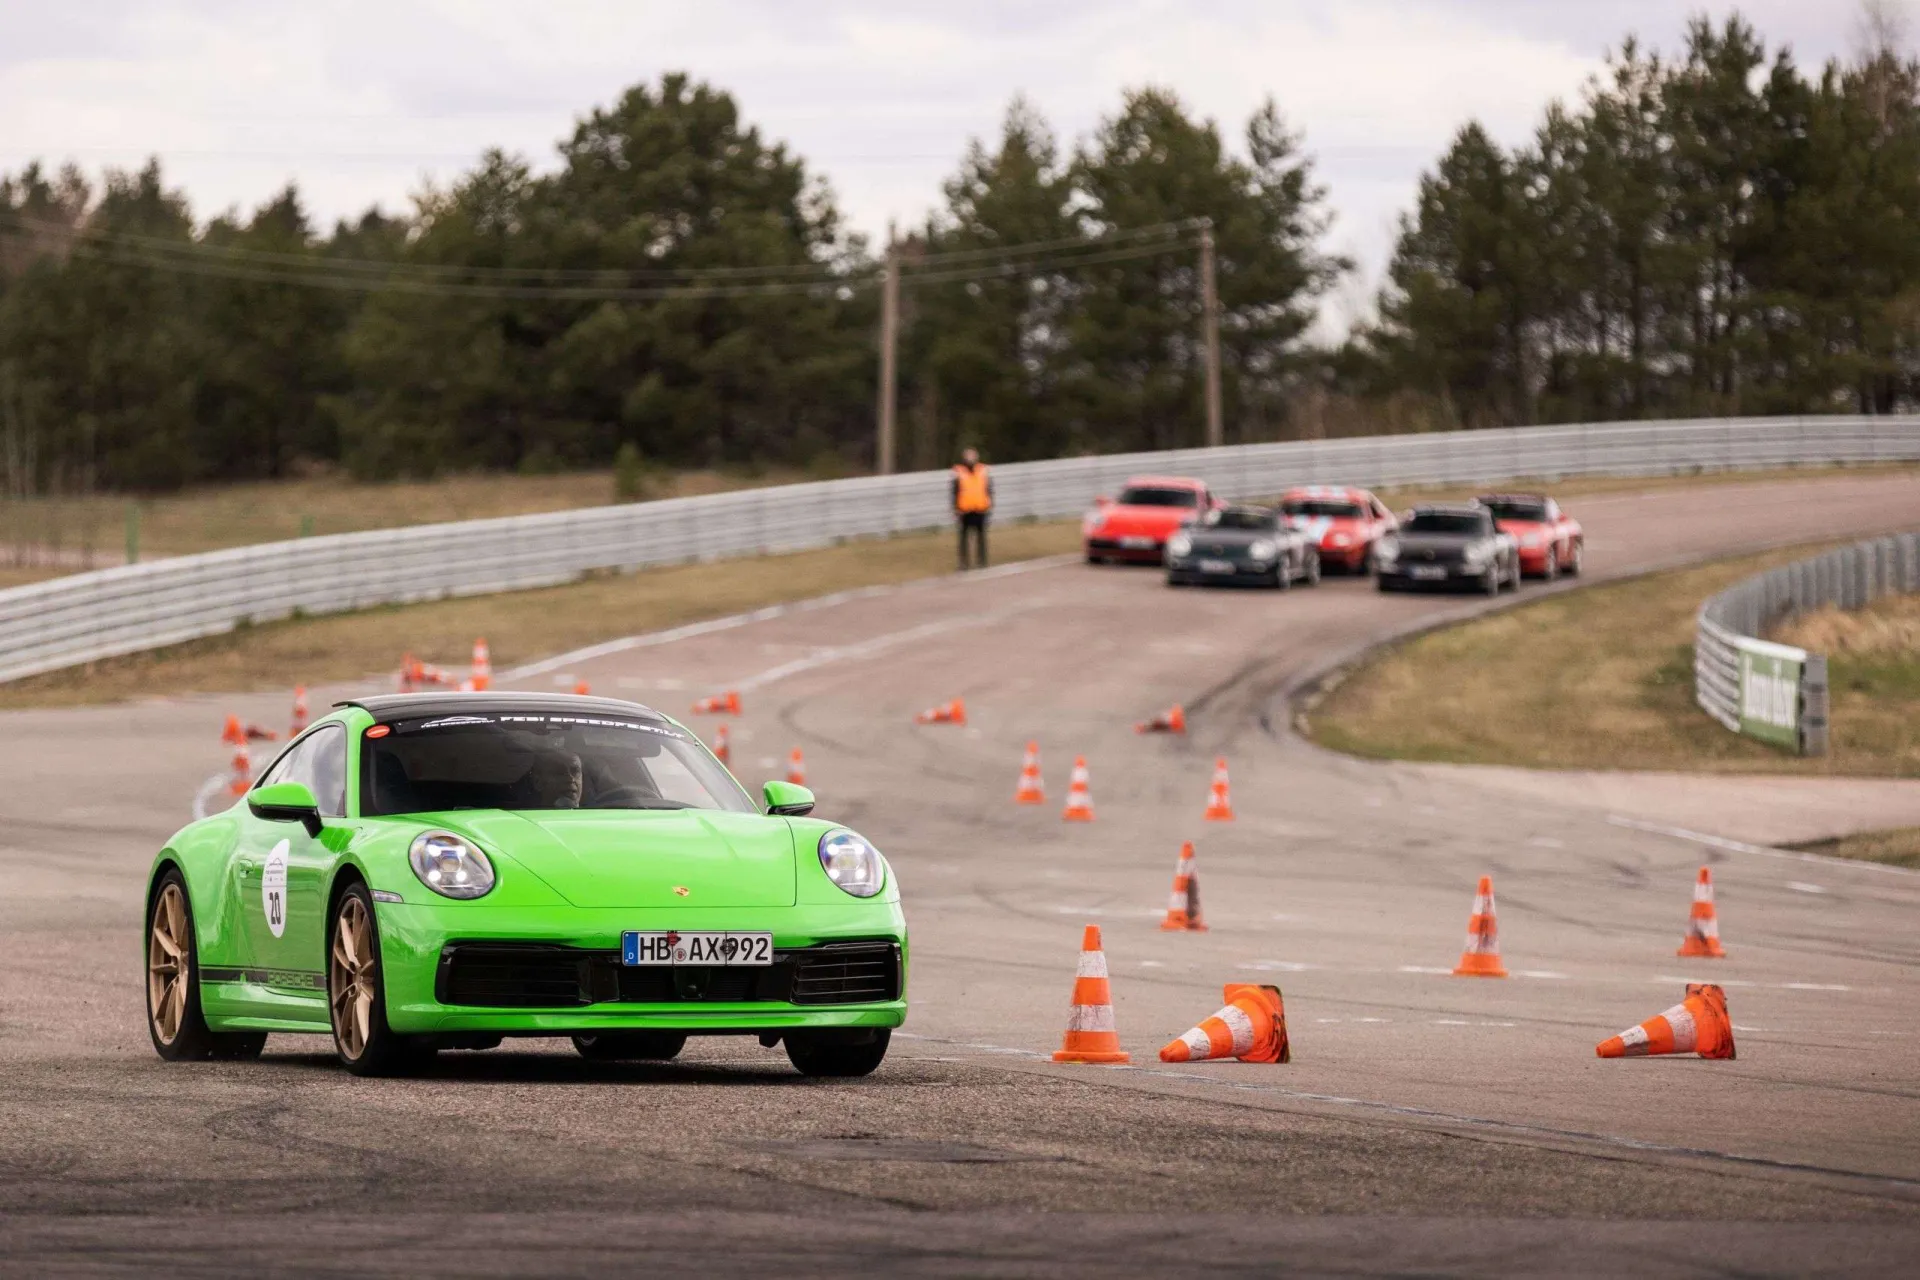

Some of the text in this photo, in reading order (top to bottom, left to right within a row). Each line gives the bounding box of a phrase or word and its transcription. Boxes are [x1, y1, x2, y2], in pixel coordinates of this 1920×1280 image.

[269, 892, 281, 925] 20
[640, 937, 769, 961] HB AX 992
